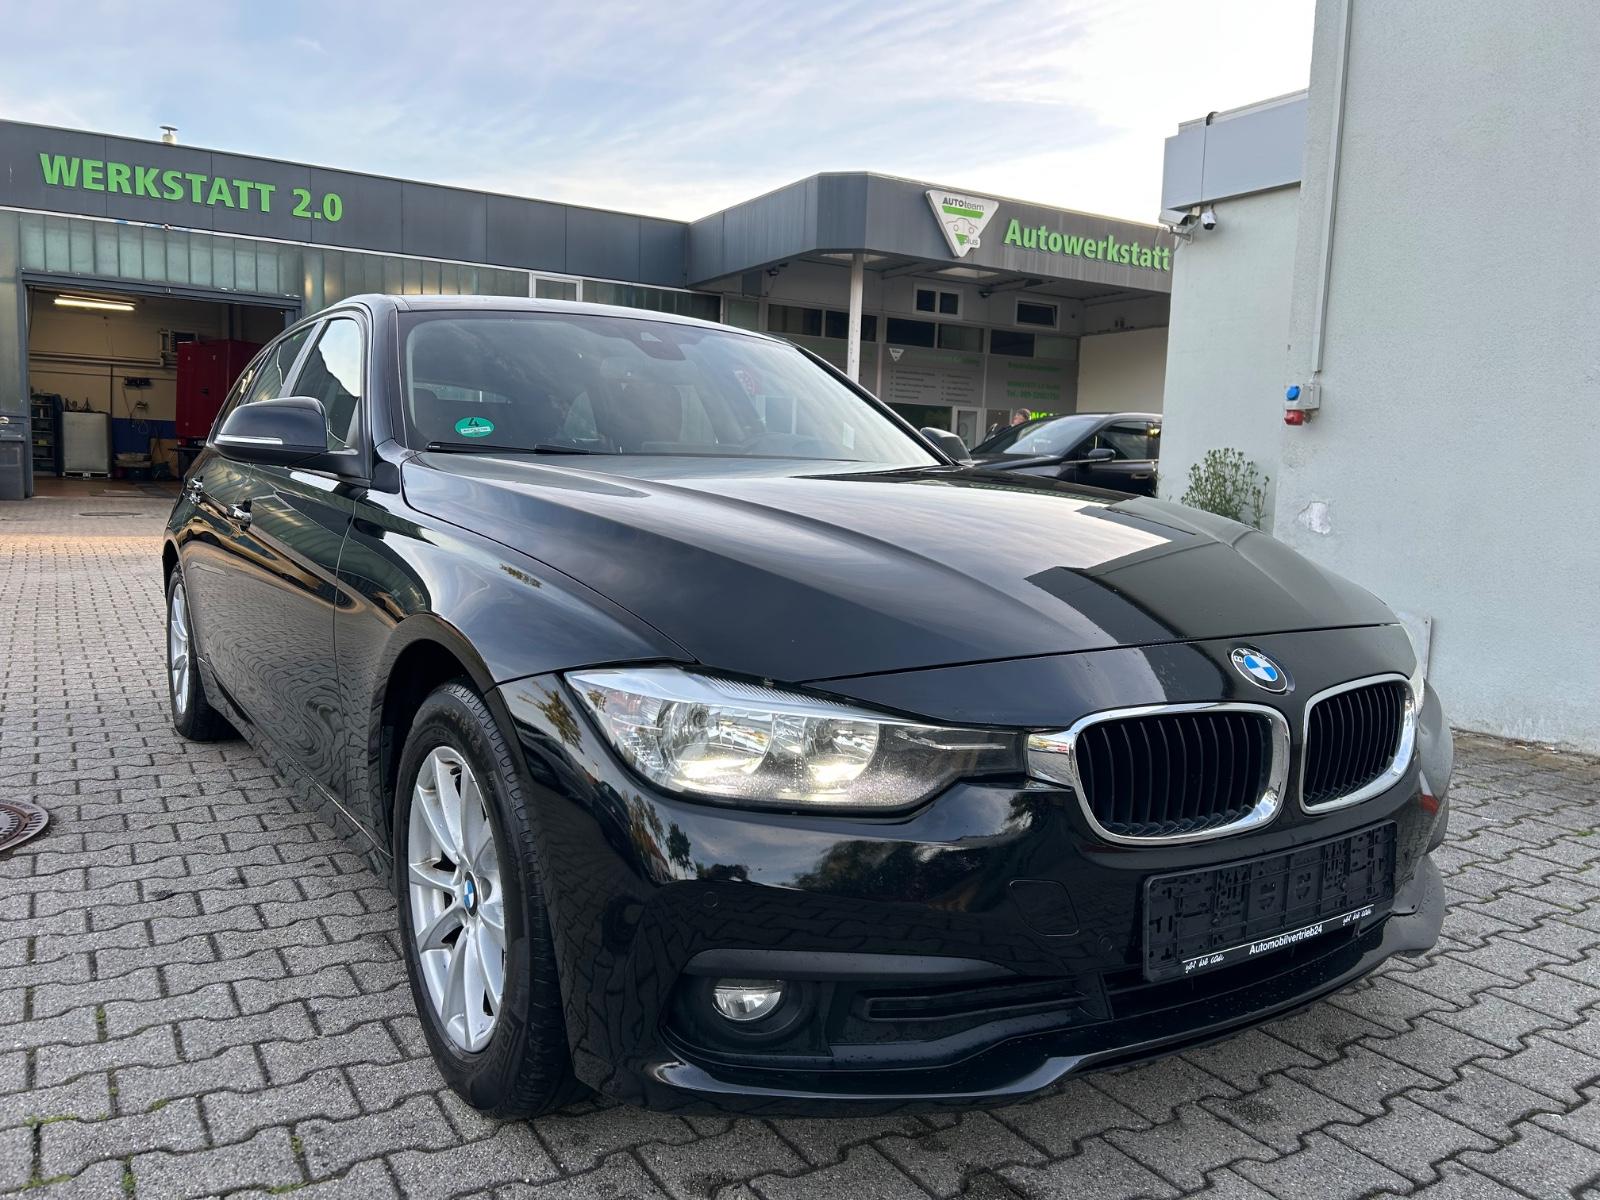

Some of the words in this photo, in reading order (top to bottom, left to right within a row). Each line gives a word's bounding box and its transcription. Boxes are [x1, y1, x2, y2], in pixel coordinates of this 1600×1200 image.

[40, 153, 276, 213] WERKSTATT
[291, 188, 344, 222] 2.0
[942, 196, 985, 212] AUTOteam
[1004, 218, 1171, 271] Autowerkstatt
[468, 417, 480, 428] 4
[1249, 924, 1323, 955] Automobilvertrieb24
